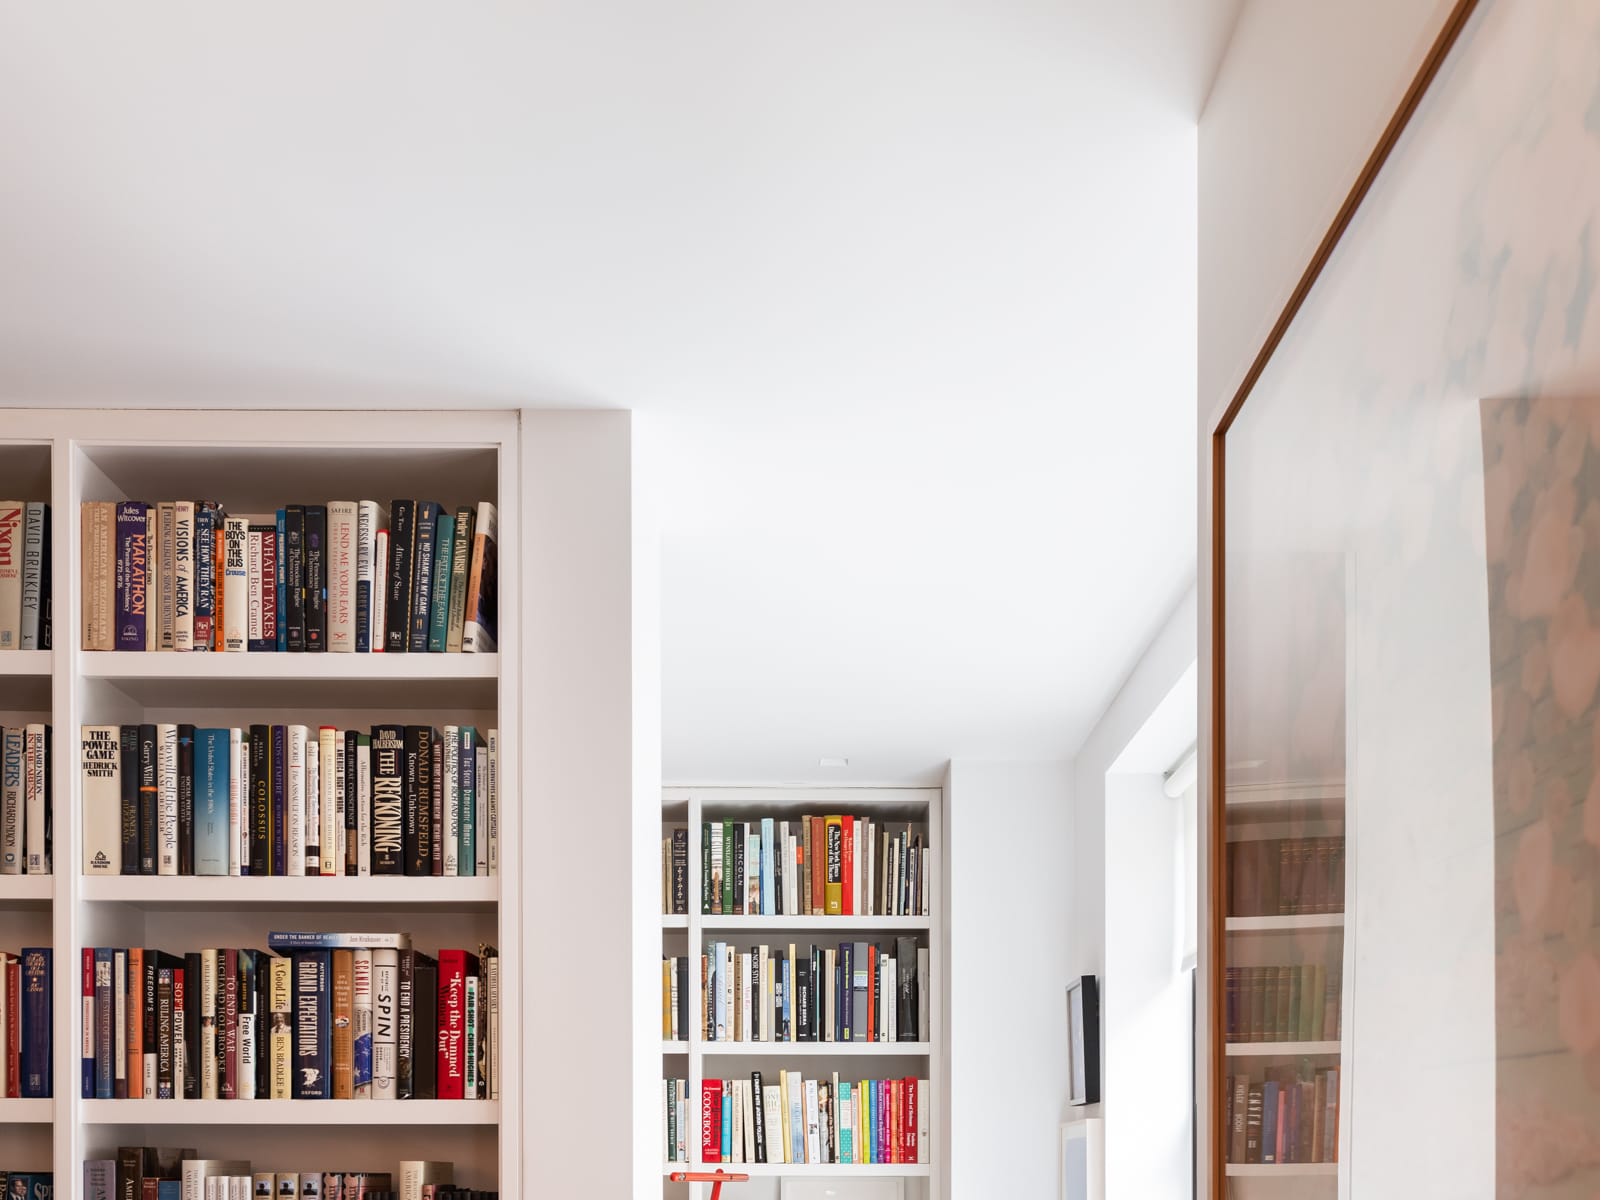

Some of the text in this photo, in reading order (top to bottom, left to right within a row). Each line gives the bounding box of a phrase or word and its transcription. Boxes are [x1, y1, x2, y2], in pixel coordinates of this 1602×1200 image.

[118, 515, 146, 523] Witcover
[122, 506, 139, 515] Jules
[227, 521, 243, 531] THE
[0, 508, 21, 565] Nixon
[225, 531, 246, 540] BOYS
[228, 540, 241, 549] ON
[422, 542, 430, 551] NO
[24, 509, 42, 610] DAVID BRINKLEY
[176, 520, 189, 618] VISIONS of AMERICA
[200, 528, 209, 608] SEE HOW THEY RAN
[227, 549, 243, 558] THE
[227, 558, 244, 567] BUS
[395, 544, 404, 570] Affairs
[420, 553, 430, 576] SHAME
[132, 534, 145, 615] MARATHON
[225, 569, 246, 577] Crouse
[250, 534, 262, 638] Richard Ben Cramer
[263, 534, 275, 638] WHAT IT TAKES
[340, 523, 350, 623] LEND ME YOUR EARS
[419, 584, 428, 594] MY
[123, 583, 131, 612] Presidency
[393, 580, 402, 600] State
[419, 596, 428, 615] GAME
[27, 733, 34, 742] IN
[82, 741, 118, 750] POWER
[89, 731, 111, 740] THE
[82, 762, 118, 770] HEDRICK
[86, 750, 115, 759] GAME
[142, 740, 153, 786] Garry Wills
[87, 769, 113, 777] SMITH
[164, 729, 176, 849] Who will tell the People
[5, 734, 21, 847] LEADERS RICHARD NIXON
[374, 750, 402, 852] THE RECKONING
[408, 752, 416, 835] Known Unknown
[418, 731, 429, 857] DONALD RUMSFELD
[275, 970, 286, 992] Good
[355, 960, 369, 996] SCANDAL
[401, 981, 410, 990] TO
[174, 982, 183, 1045] SOFT POWER
[218, 955, 226, 1073] RICHARD HOLBROOKE
[227, 975, 235, 1053] TO END A WAR
[275, 994, 286, 1010] Life
[298, 962, 318, 1057] GRAND EXPECTATIONS
[400, 992, 410, 1006] END
[377, 994, 391, 1037] SPIN
[449, 1010, 461, 1028] the
[160, 999, 170, 1073] RULING AMERICA
[242, 1016, 252, 1064] Free World
[398, 1014, 410, 1058] PRESIDENCY
[276, 1036, 285, 1087] BEN BRADLEE
[448, 1030, 461, 1077] Damned
[703, 1091, 711, 1146] COOKBOOK
